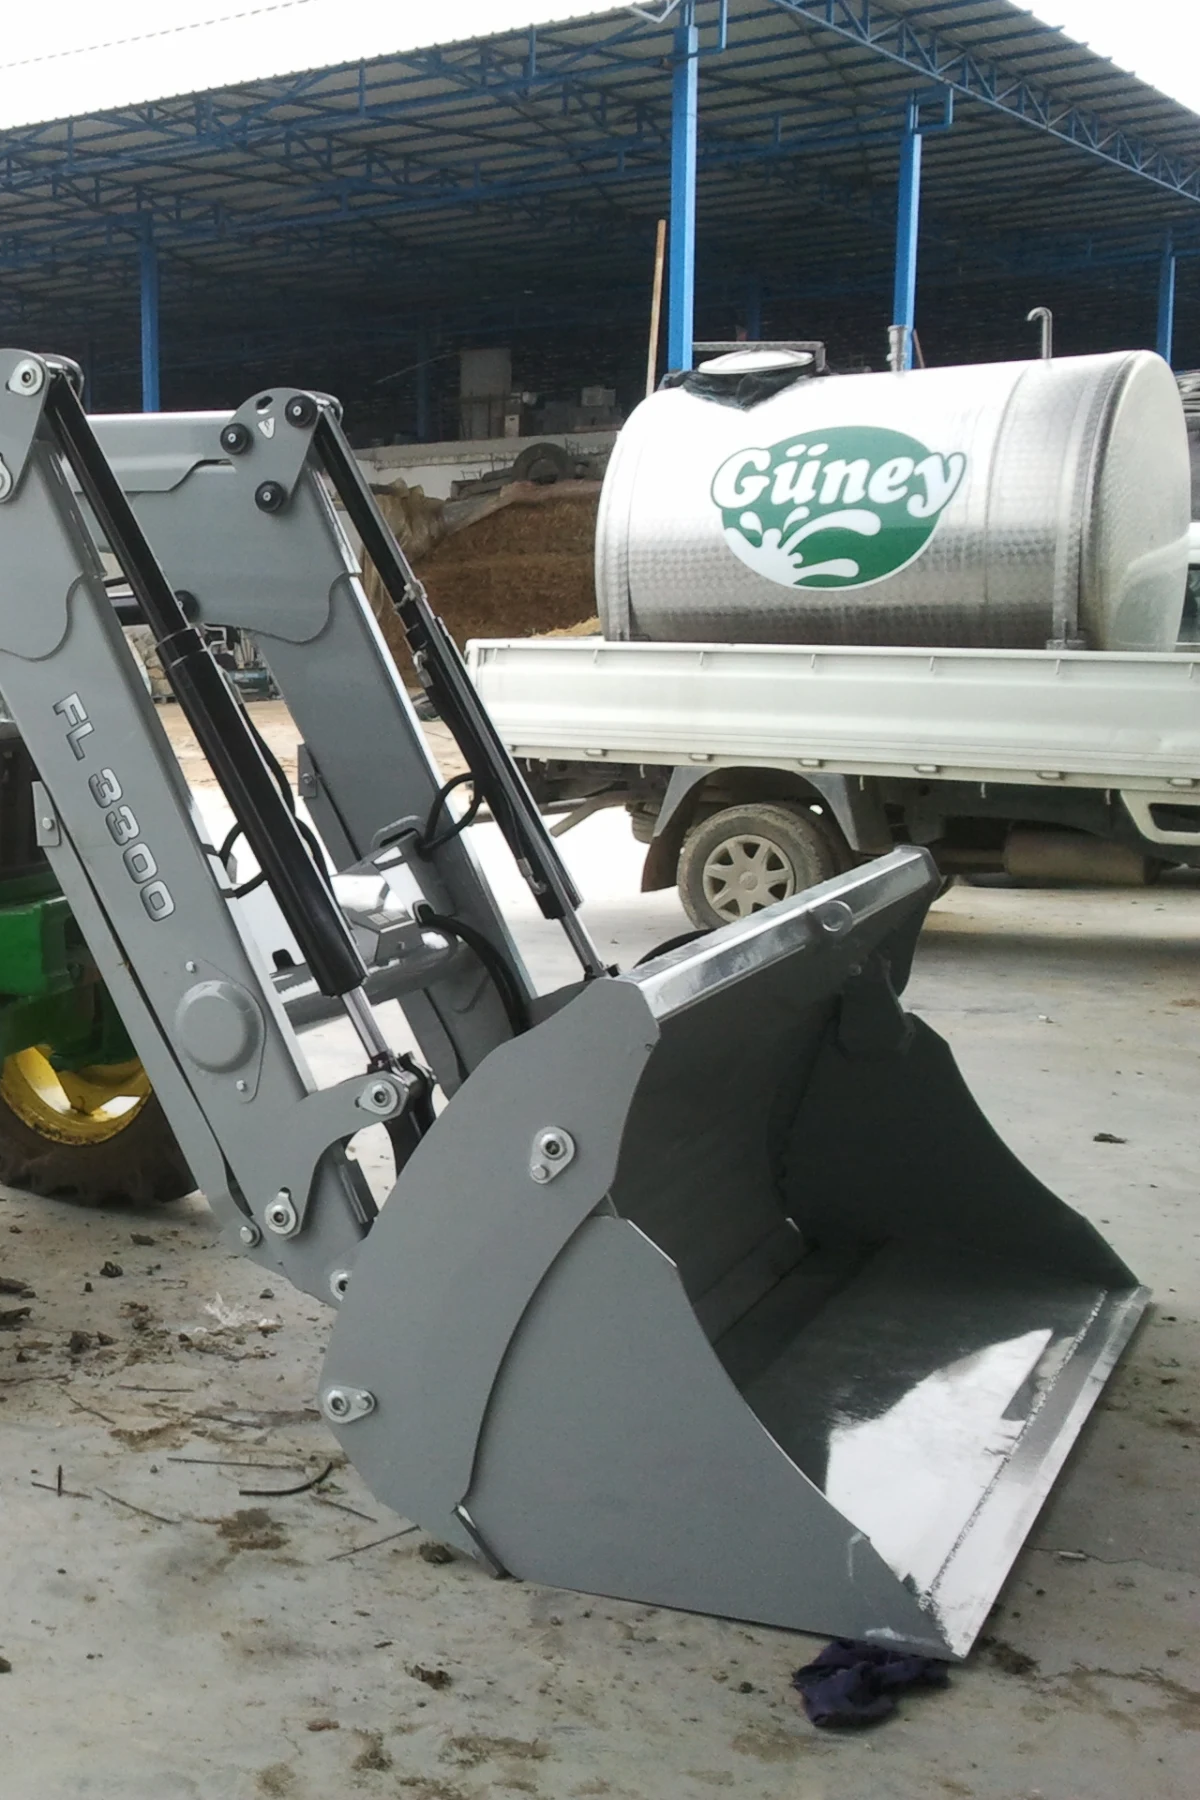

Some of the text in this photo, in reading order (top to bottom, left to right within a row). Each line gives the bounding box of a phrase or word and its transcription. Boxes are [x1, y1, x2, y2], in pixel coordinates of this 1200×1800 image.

[712, 443, 966, 518] Güney
[52, 692, 175, 922] FL 3300
